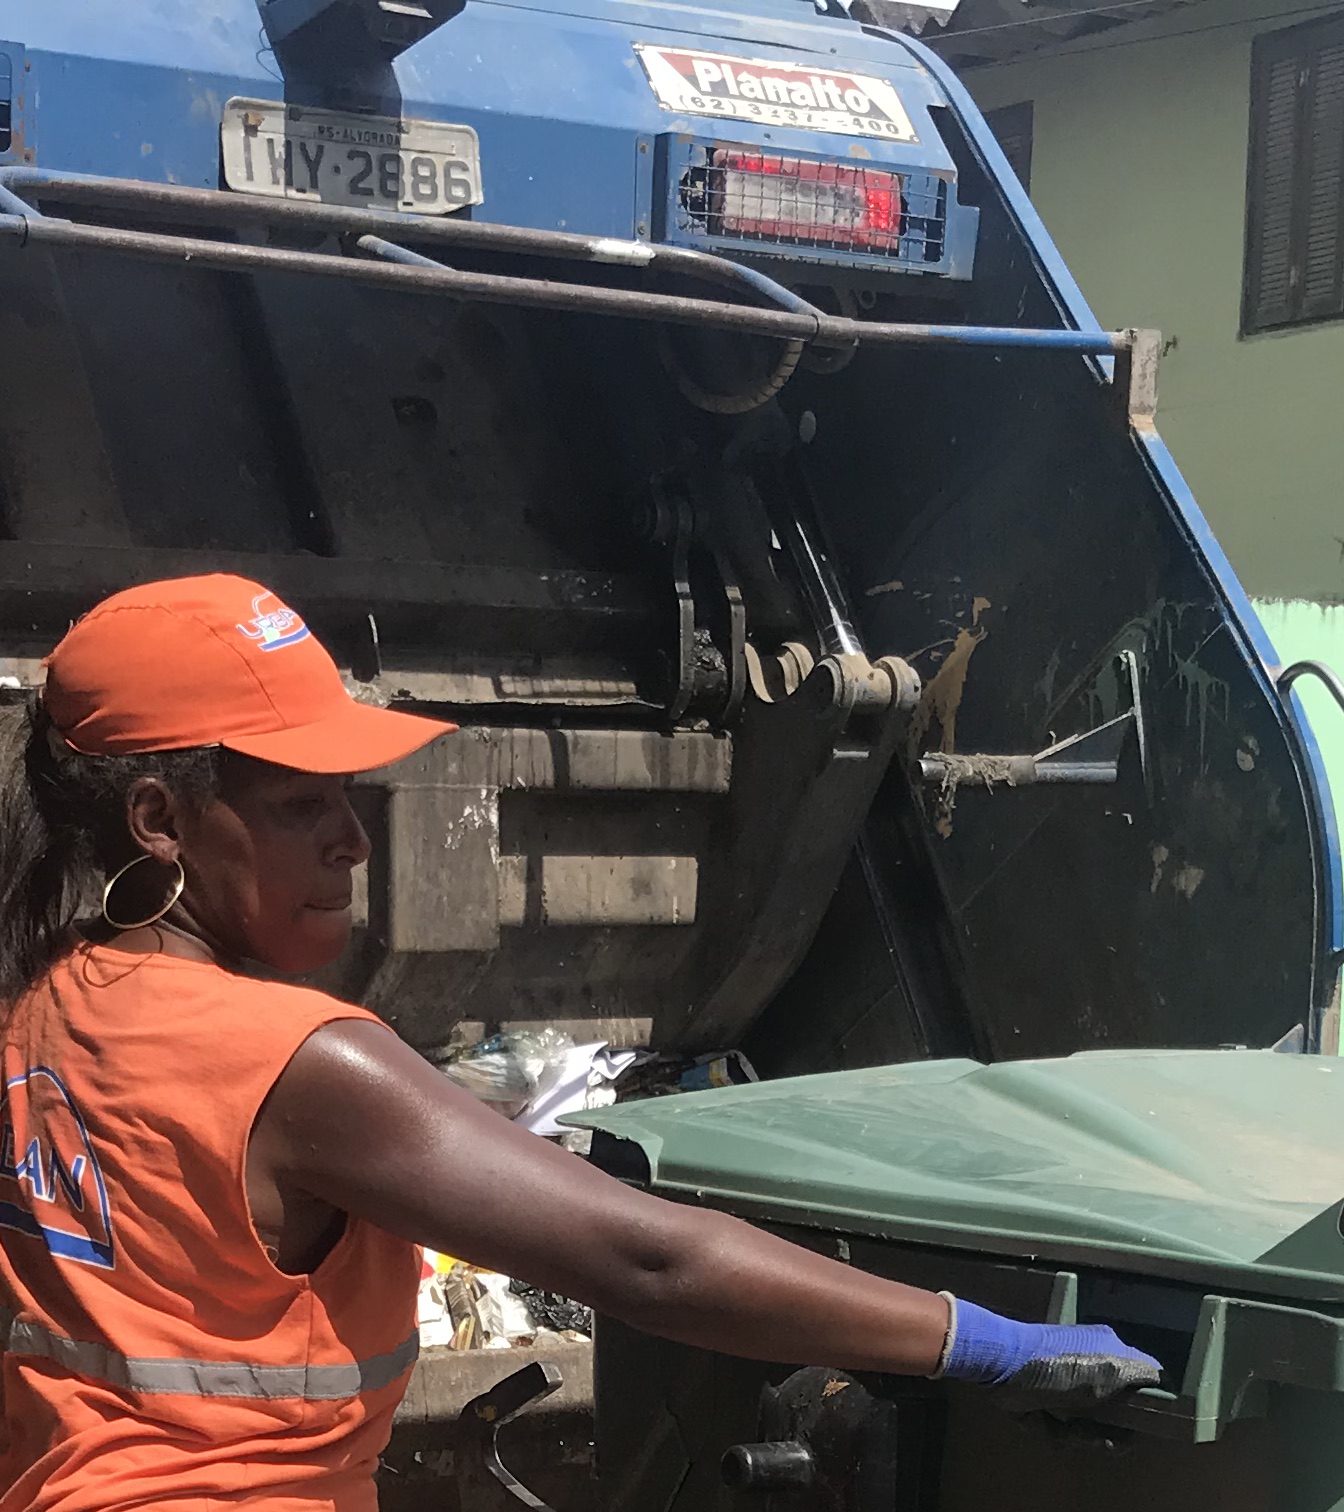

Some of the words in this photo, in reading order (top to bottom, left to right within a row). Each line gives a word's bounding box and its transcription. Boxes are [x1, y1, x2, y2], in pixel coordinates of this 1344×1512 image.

[691, 60, 871, 114] Planalto
[679, 95, 737, 114] (62)
[235, 607, 296, 640] URBA
